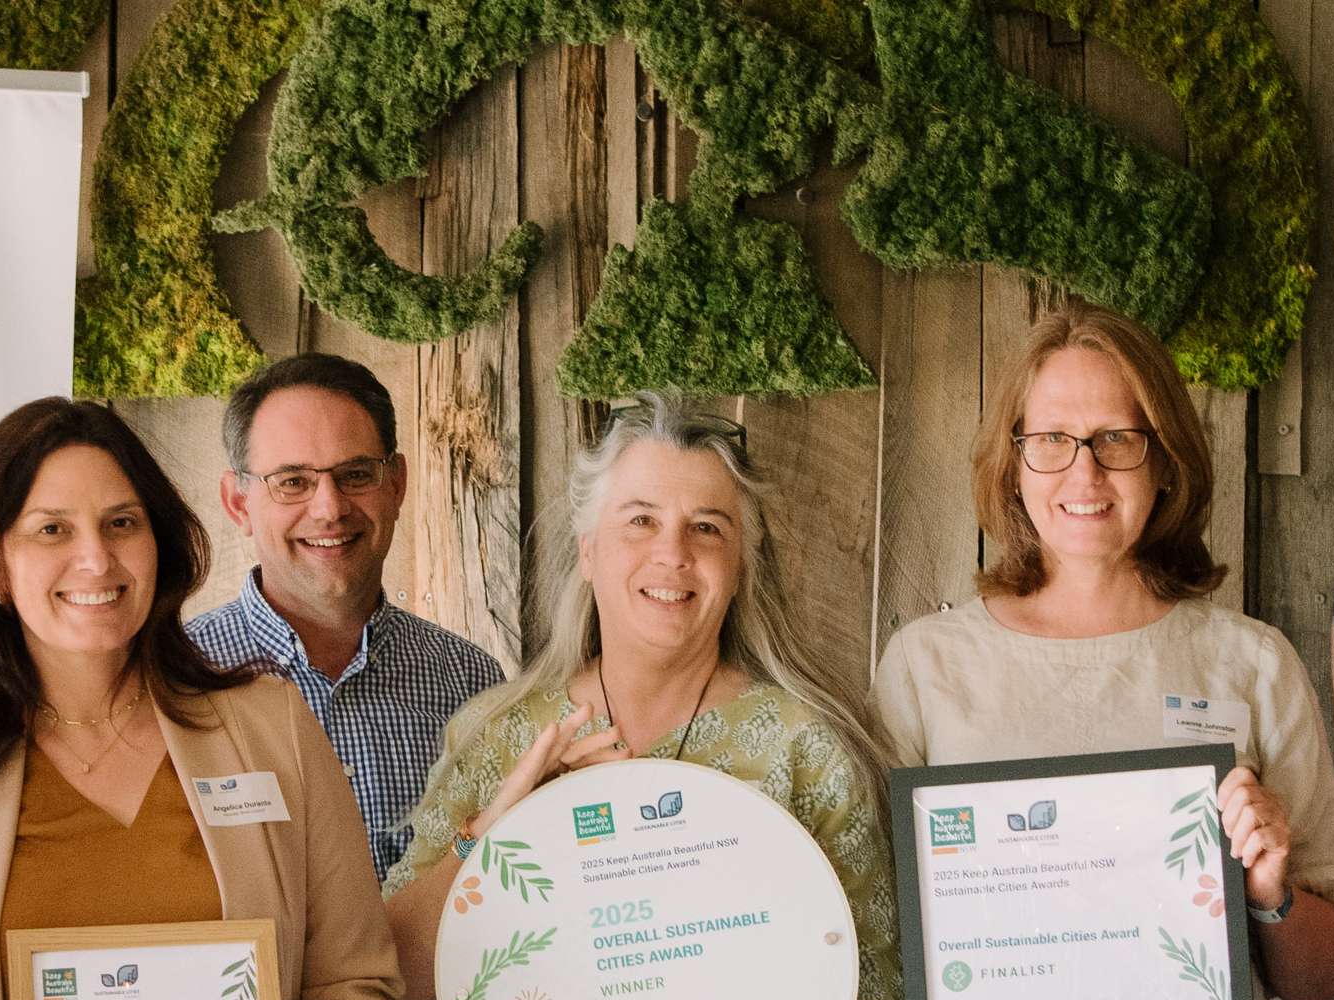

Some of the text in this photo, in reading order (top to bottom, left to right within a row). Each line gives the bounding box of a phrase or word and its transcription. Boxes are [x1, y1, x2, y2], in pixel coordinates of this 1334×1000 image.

[577, 809, 595, 818] Keep
[578, 817, 608, 826] Australia
[579, 825, 611, 835] Beautiful
[934, 823, 969, 833] Australia
[934, 831, 972, 842] Beautiful
[581, 837, 739, 870] 2025 Keep Australia Beautiful NSW
[583, 858, 701, 883] Sustainable Cities Awards
[934, 859, 1116, 881] 2025 Keep Australia Beautiful NSW
[998, 882, 1027, 892] Cities
[1031, 878, 1070, 889] Awards
[589, 899, 654, 929] 2025
[594, 911, 770, 950] OVERALL SUSTAINABLE
[939, 927, 1140, 951] Overall Sustainable Cities Award
[597, 943, 704, 971] CITIES AWARD
[981, 964, 1056, 979] FINALIST
[47, 986, 75, 994] Beautiful
[600, 976, 665, 997] WINNER
